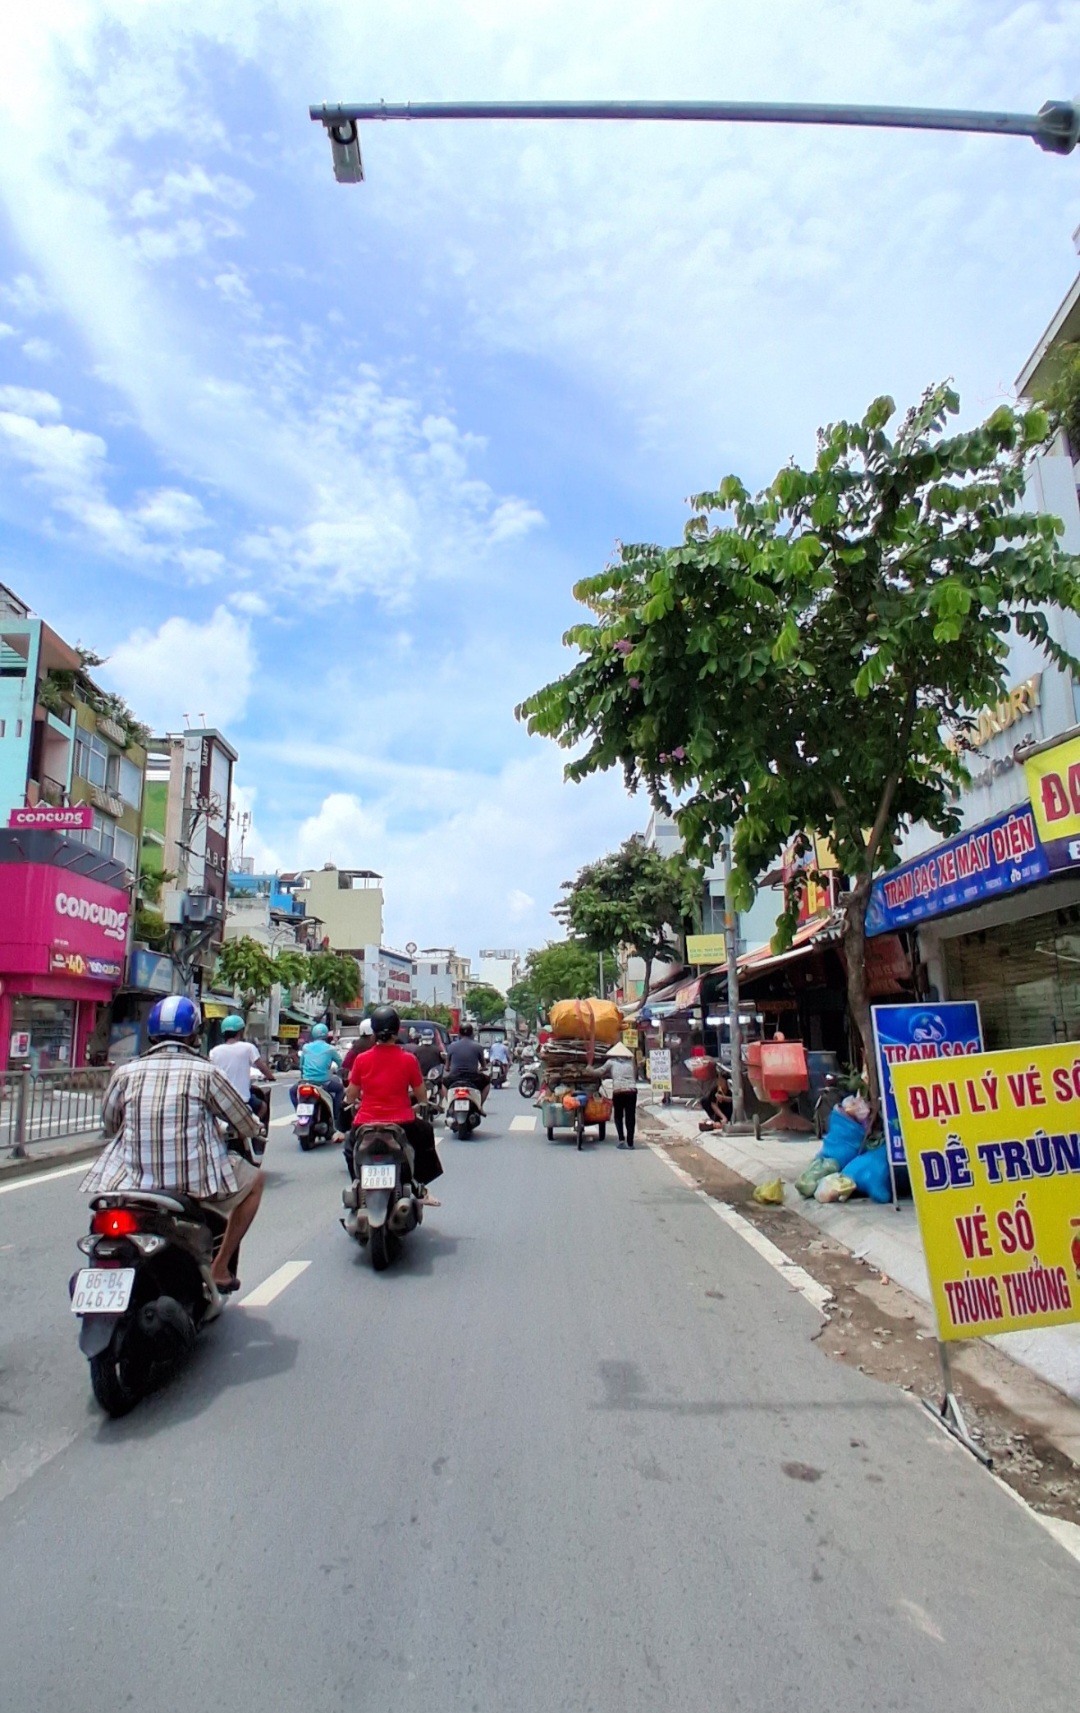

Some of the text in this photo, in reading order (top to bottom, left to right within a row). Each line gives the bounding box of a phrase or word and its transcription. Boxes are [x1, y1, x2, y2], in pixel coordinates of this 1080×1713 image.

[946, 672, 1042, 757] UXURY
[884, 870, 914, 909] TRẠM
[913, 859, 938, 899] SẠC
[937, 850, 956, 887] XE
[956, 834, 991, 878] MÁY
[992, 813, 1036, 863] ĐIỆN
[909, 1082, 961, 1124] ĐẠI
[966, 1070, 998, 1113] LÝ
[1007, 1065, 1046, 1107] VÉ
[920, 1133, 974, 1191] DỄ
[955, 1193, 1035, 1259] VÉ SỐ
[76, 1290, 126, 1308] 046.75
[944, 1255, 1072, 1325] TRÚNG THƯỞNG
